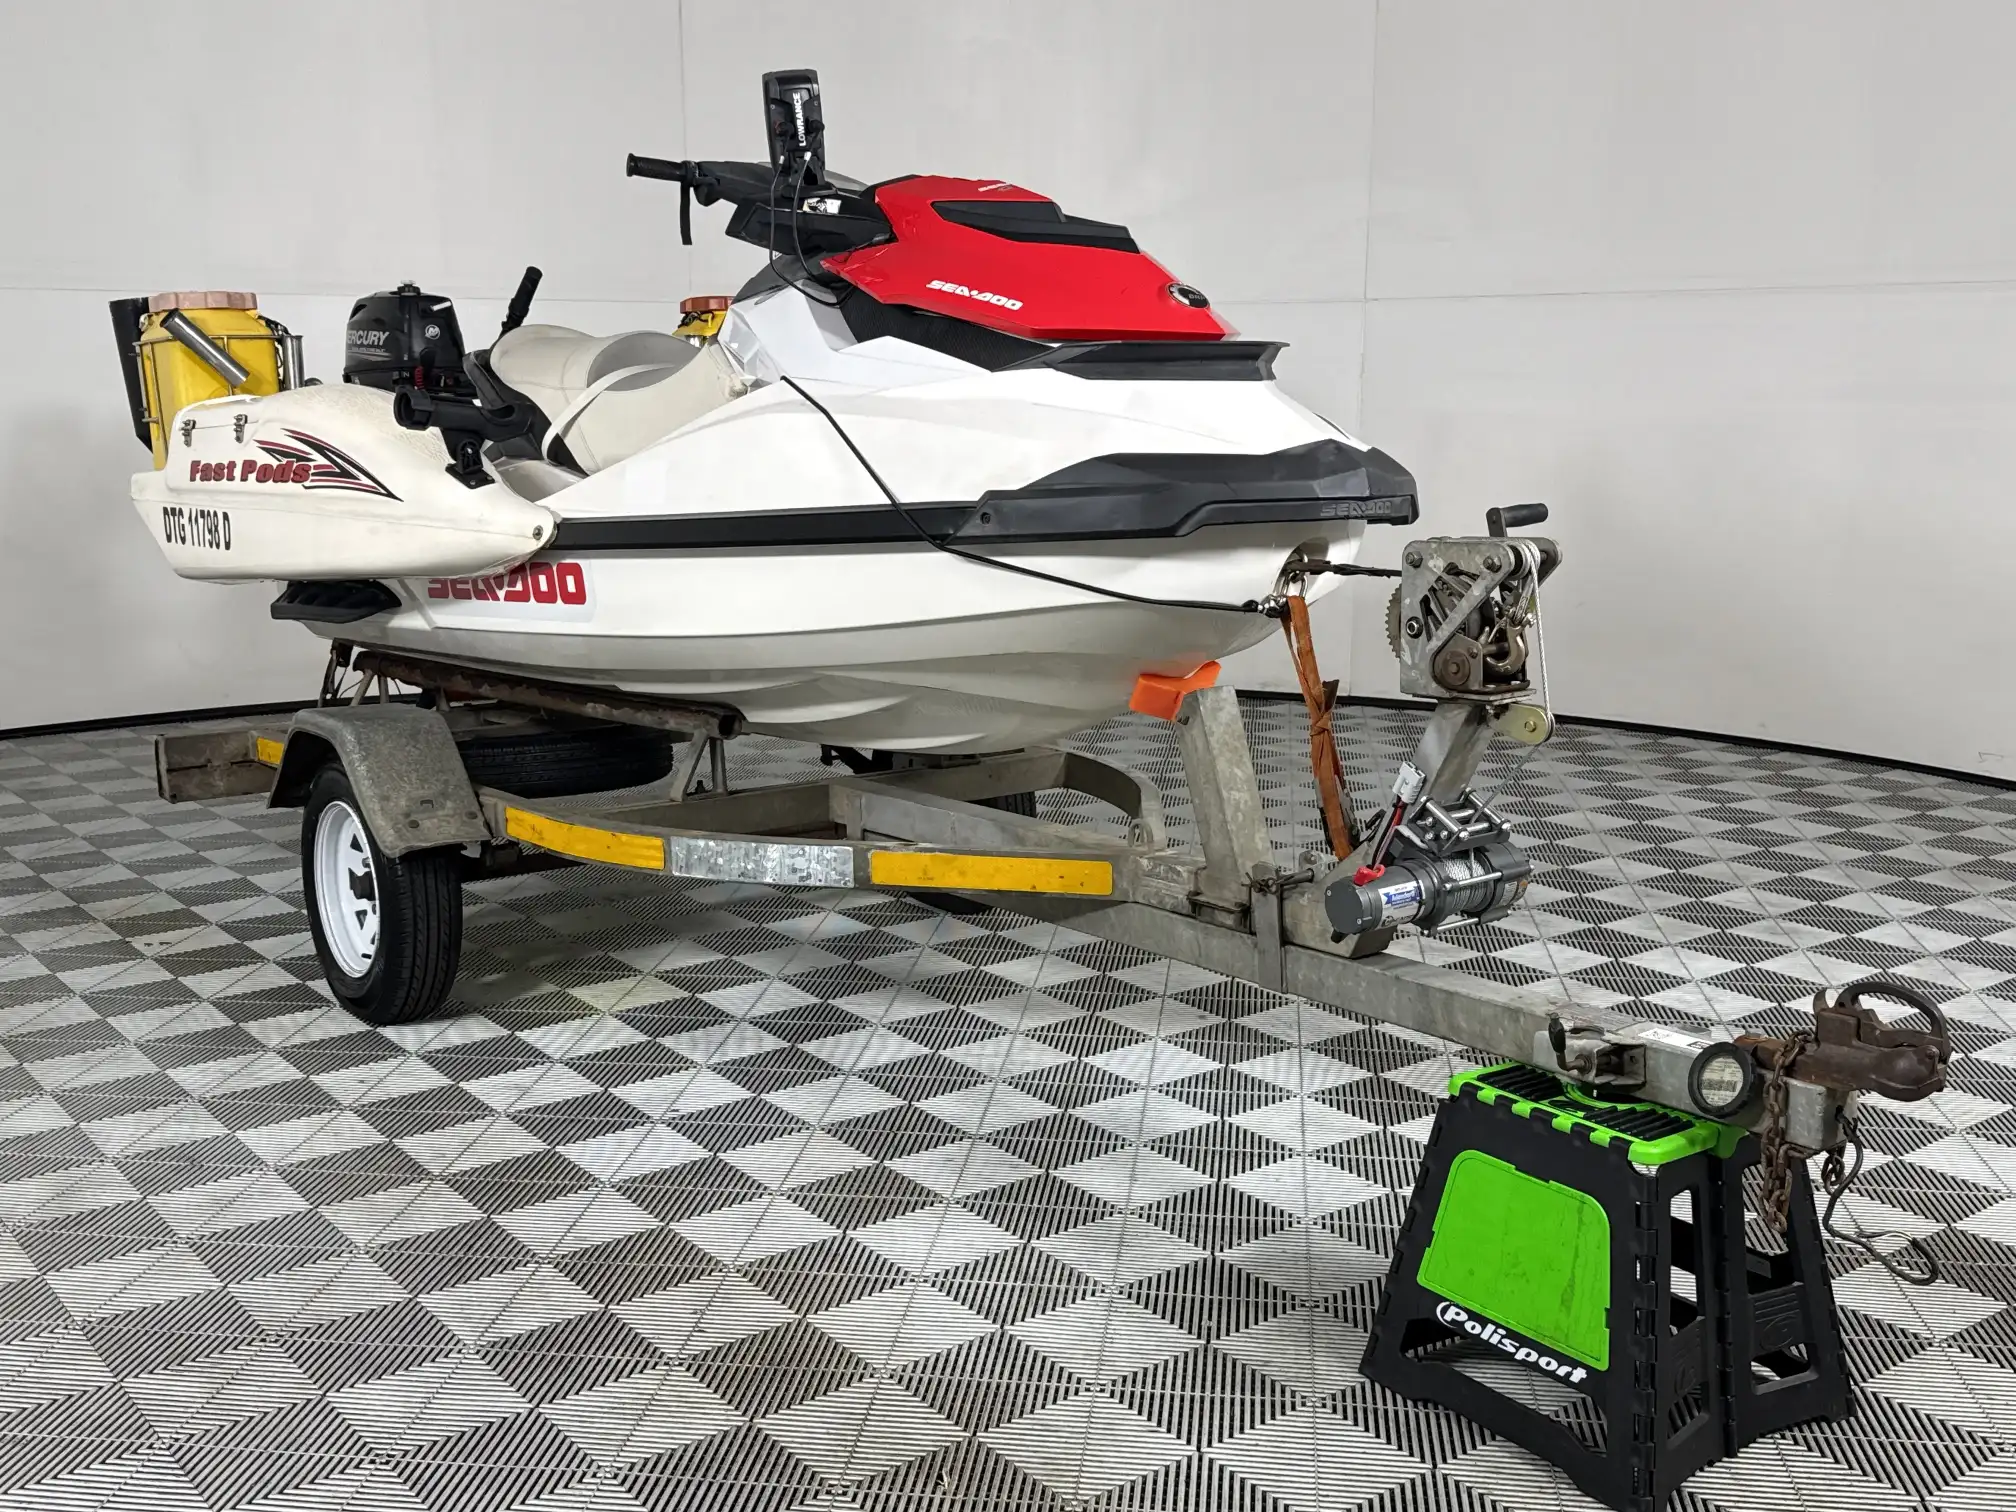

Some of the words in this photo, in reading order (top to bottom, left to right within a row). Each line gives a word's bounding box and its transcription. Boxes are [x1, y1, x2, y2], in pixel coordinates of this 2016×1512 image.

[793, 91, 806, 146] LOWRANCE
[347, 330, 390, 346] ERCURY
[190, 460, 237, 482] Fast
[240, 460, 312, 484] Pods
[163, 506, 186, 545] DTG
[188, 508, 220, 550] 11798
[222, 511, 231, 551] D
[1440, 1303, 1588, 1384] Polisport
